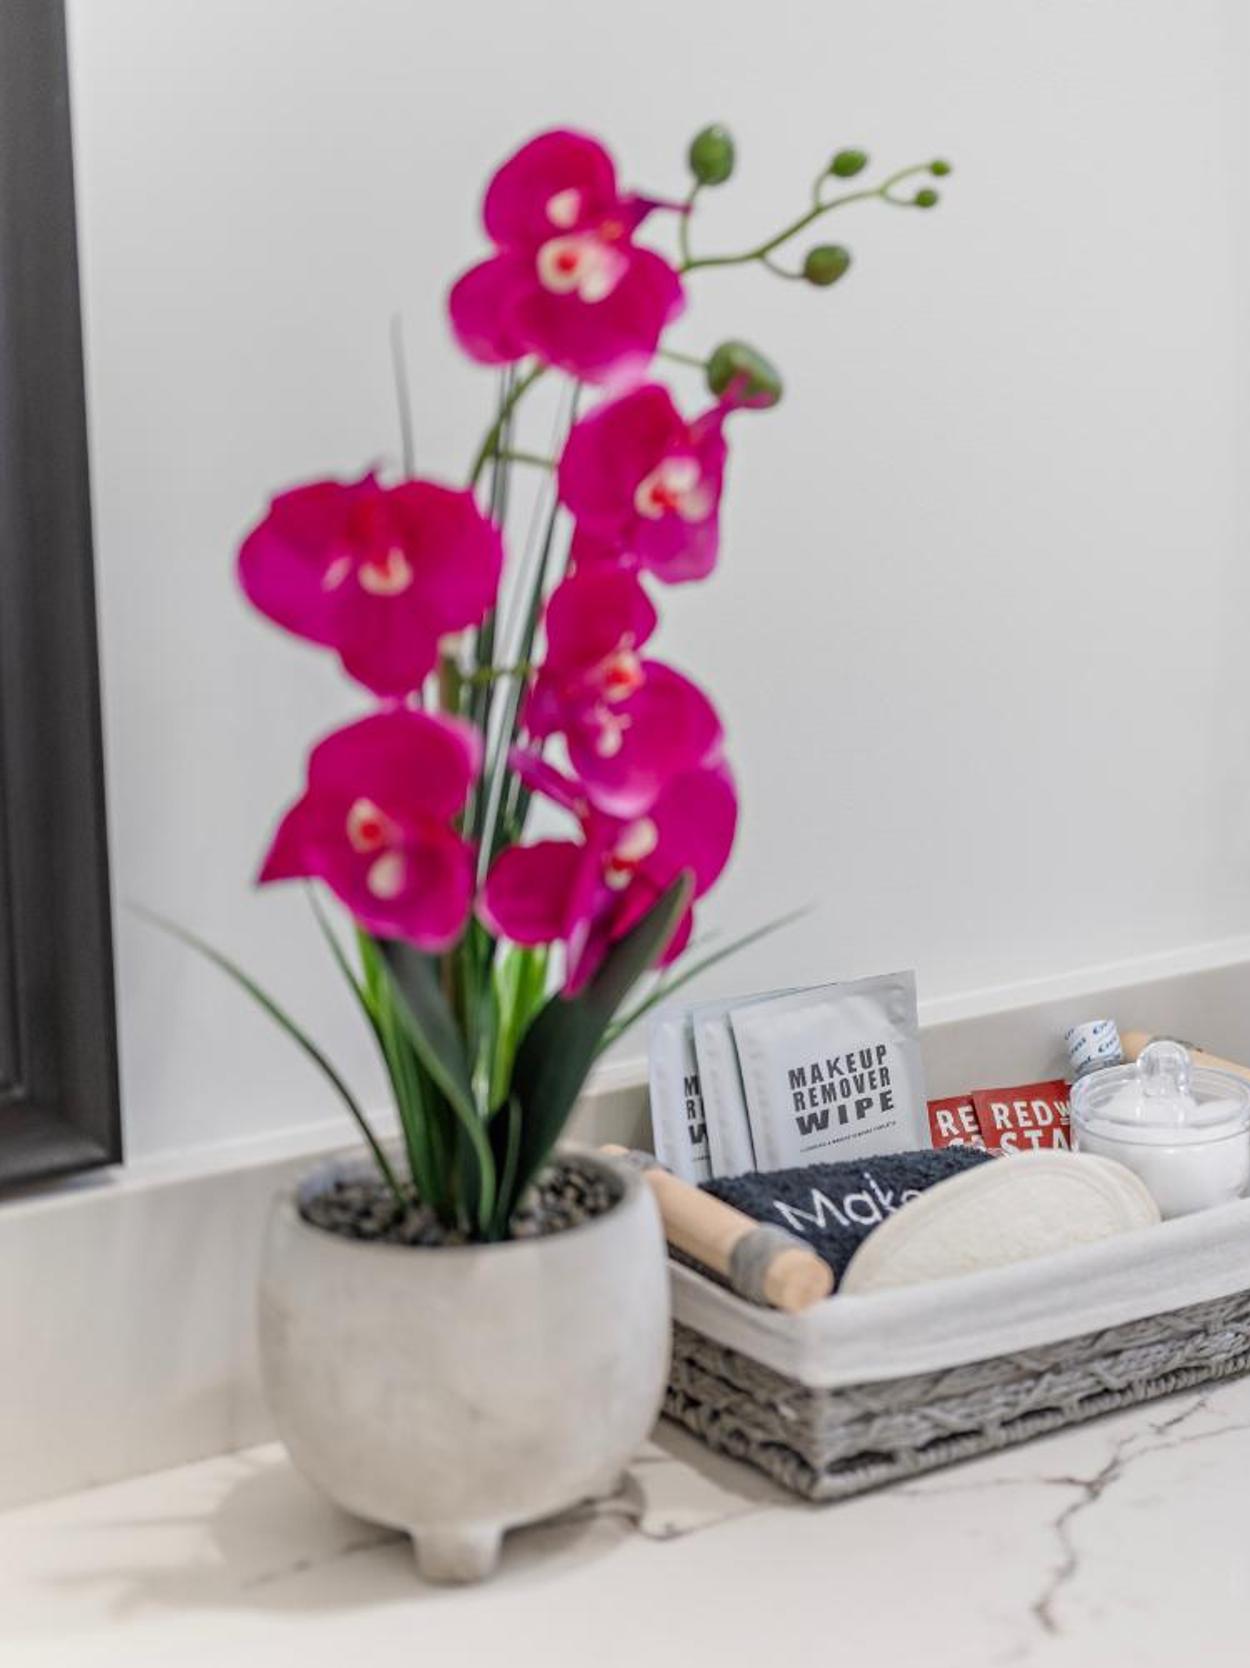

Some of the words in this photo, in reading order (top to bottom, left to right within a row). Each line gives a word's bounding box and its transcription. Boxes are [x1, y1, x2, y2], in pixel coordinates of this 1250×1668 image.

[787, 1044, 887, 1091] MAKEUP
[792, 1067, 891, 1112] REMOVER
[796, 1090, 894, 1135] WIPE
[990, 1100, 1054, 1129] RED
